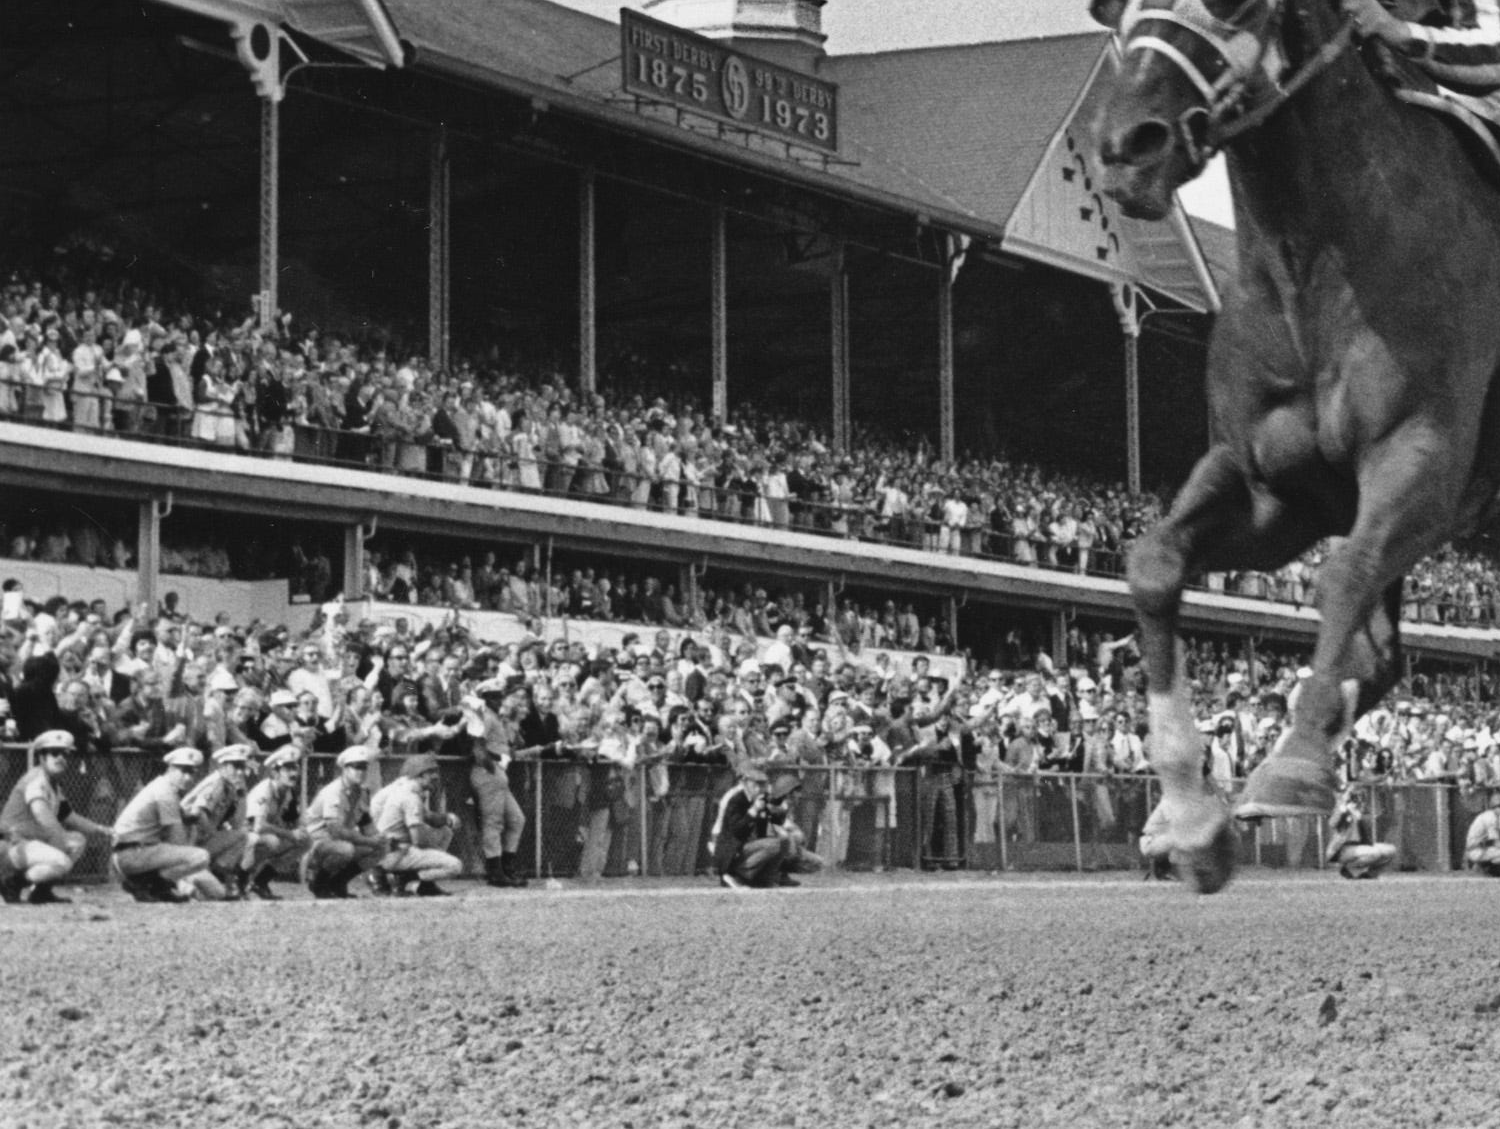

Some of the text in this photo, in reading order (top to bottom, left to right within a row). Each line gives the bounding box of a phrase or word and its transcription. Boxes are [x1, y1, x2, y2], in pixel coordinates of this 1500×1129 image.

[632, 27, 717, 72] FIRST DERBY
[639, 54, 709, 103] 1875
[792, 80, 833, 110] DERBY
[763, 94, 829, 140] 1973
